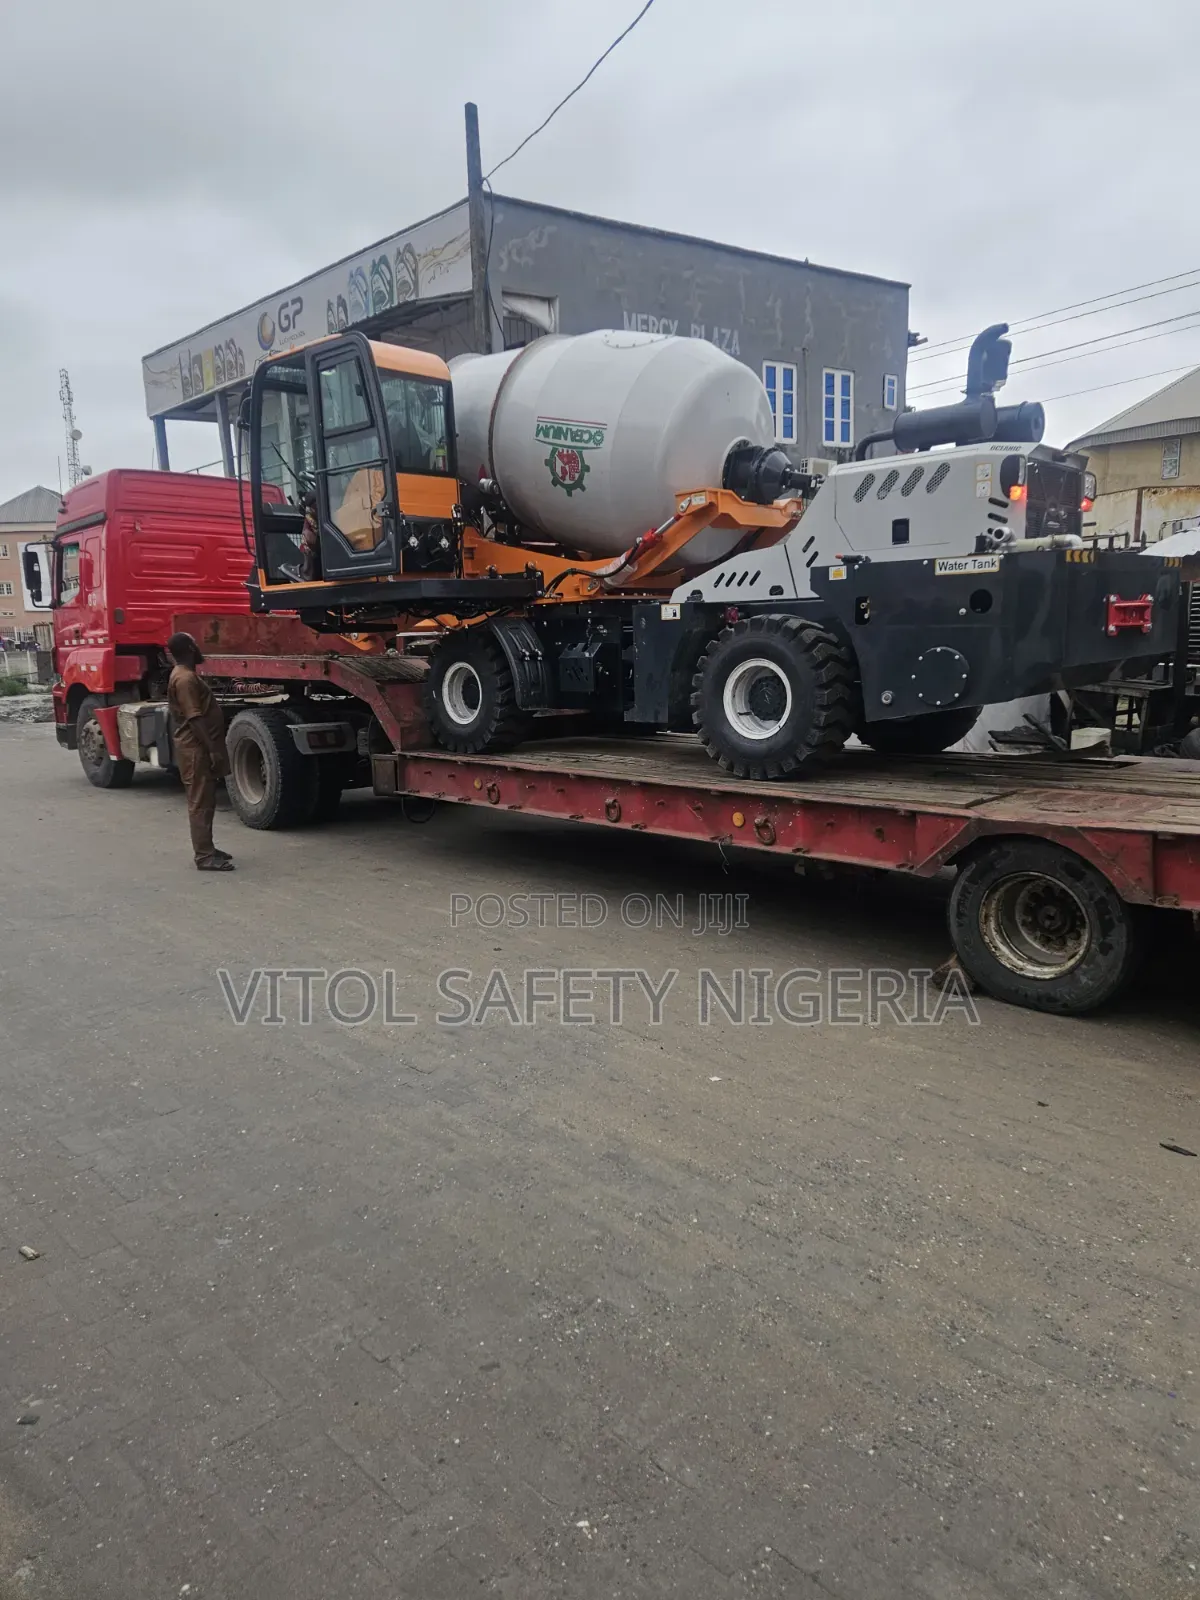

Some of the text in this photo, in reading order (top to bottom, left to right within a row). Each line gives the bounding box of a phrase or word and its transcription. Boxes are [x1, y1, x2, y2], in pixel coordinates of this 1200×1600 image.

[623, 311, 679, 336] MERCY
[938, 558, 997, 571] Water Tank
